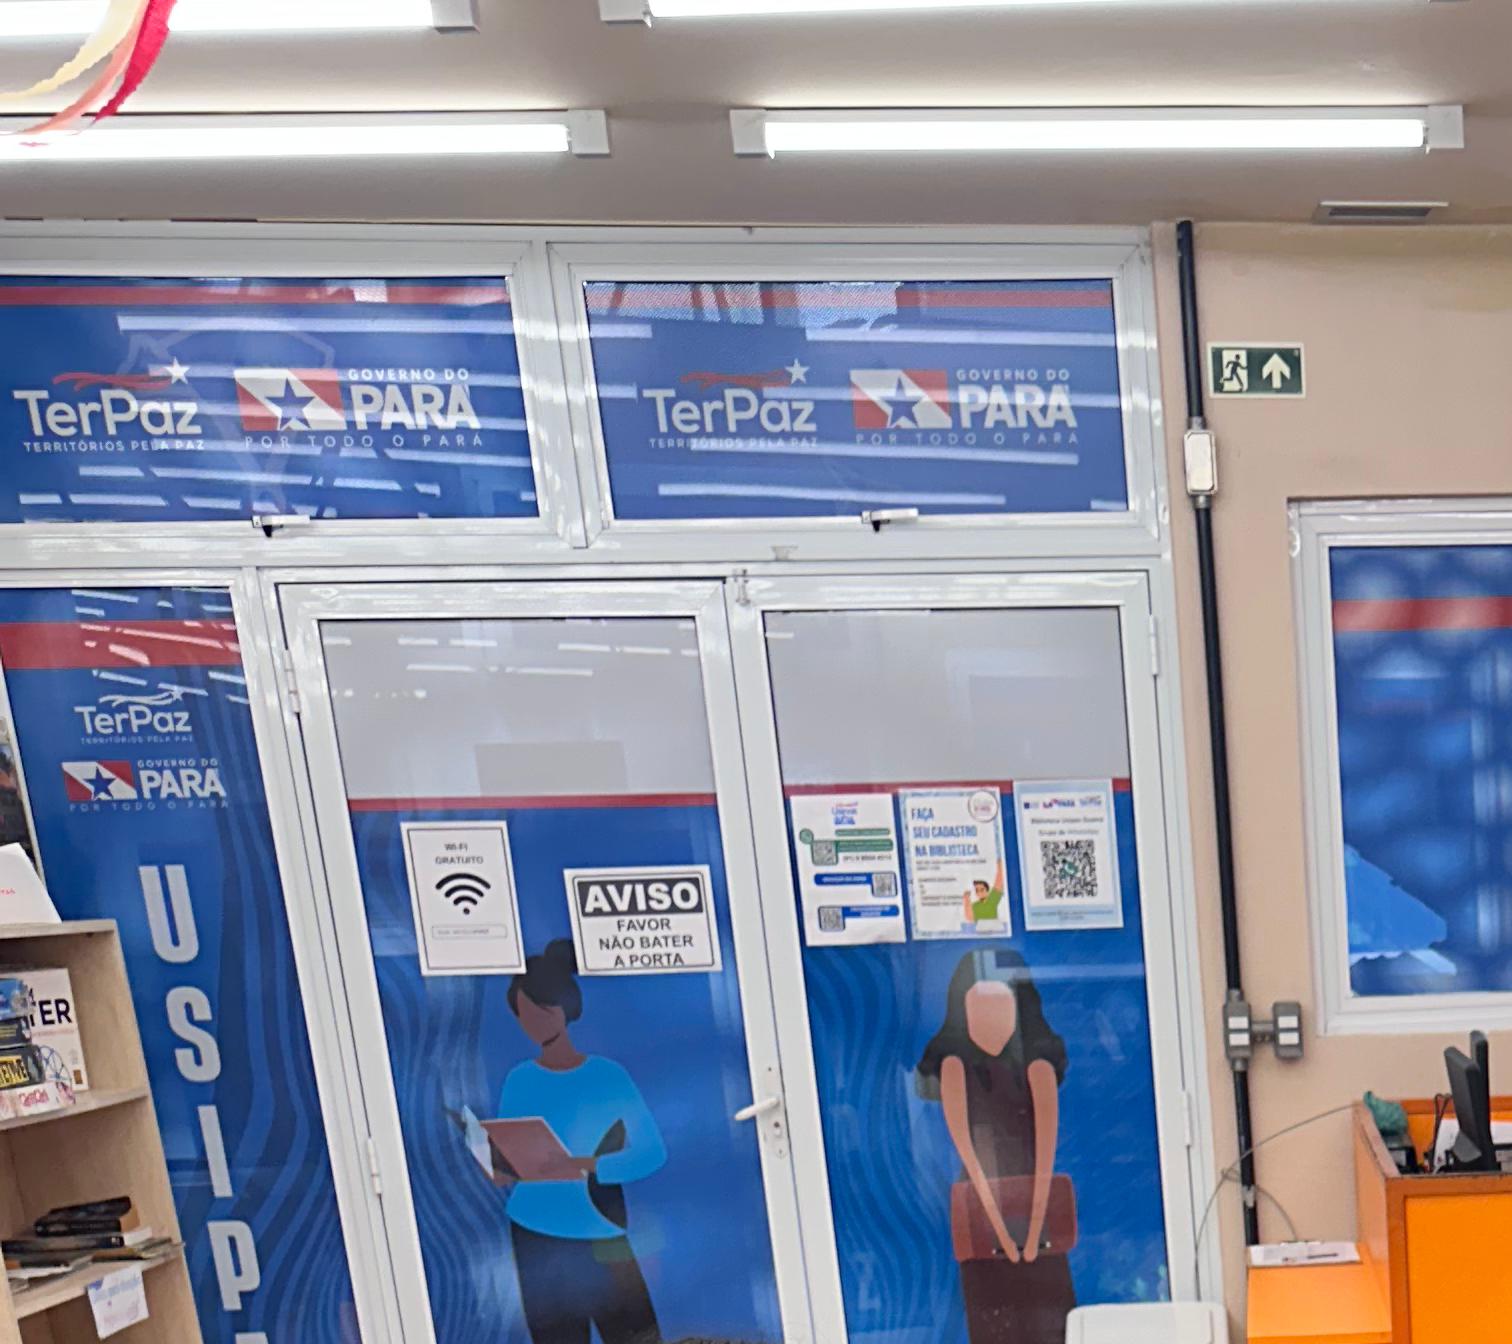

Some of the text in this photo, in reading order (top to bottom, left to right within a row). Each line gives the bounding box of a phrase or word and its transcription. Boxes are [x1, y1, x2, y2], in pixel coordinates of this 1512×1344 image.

[348, 368, 470, 382] GOVERNO DO
[956, 369, 1071, 382] GOVERNO DO
[12, 388, 203, 437] TerPaz
[643, 388, 817, 435] TerPaz
[23, 438, 206, 453] TERRITÓRIOS PELA PAZ
[244, 436, 290, 448] POR
[308, 435, 375, 448] TODO
[393, 434, 405, 447] O
[856, 433, 896, 445] POR
[915, 433, 978, 445] TODO
[993, 433, 1005, 445] O
[74, 704, 192, 735] TerPaz
[137, 758, 219, 768] GOVERNO DO
[434, 855, 484, 865] GRATUITO
[581, 881, 700, 914] AVISO
[616, 918, 672, 933] FAVOR
[598, 934, 695, 952] NÃO BATER
[613, 952, 685, 968] A PORTA
